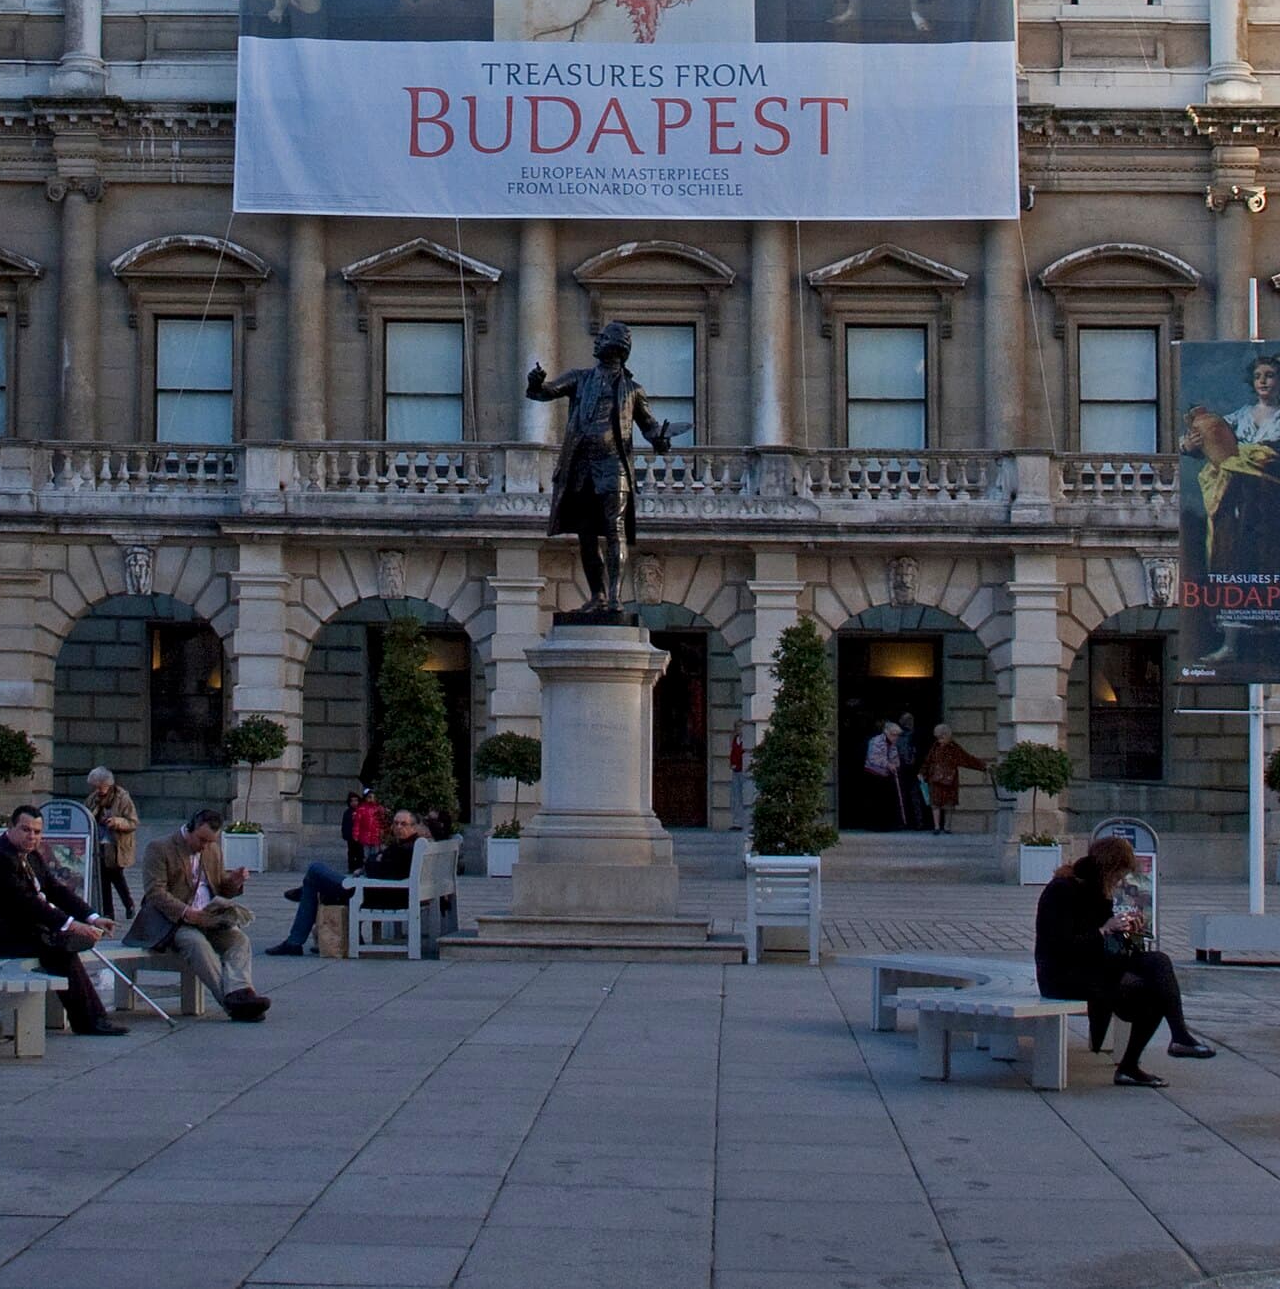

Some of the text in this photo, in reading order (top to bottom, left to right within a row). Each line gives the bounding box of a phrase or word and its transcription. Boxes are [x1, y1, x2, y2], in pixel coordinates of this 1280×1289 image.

[482, 62, 768, 88] TREASURES FROM
[404, 86, 848, 158] BUDAPEST
[521, 167, 729, 181] EUROPEAN MASTERPIECES
[507, 182, 744, 197] FROM LEONARDO TO SCHIELE
[496, 495, 551, 512] ROYA
[1208, 574, 1271, 584] TREASURES
